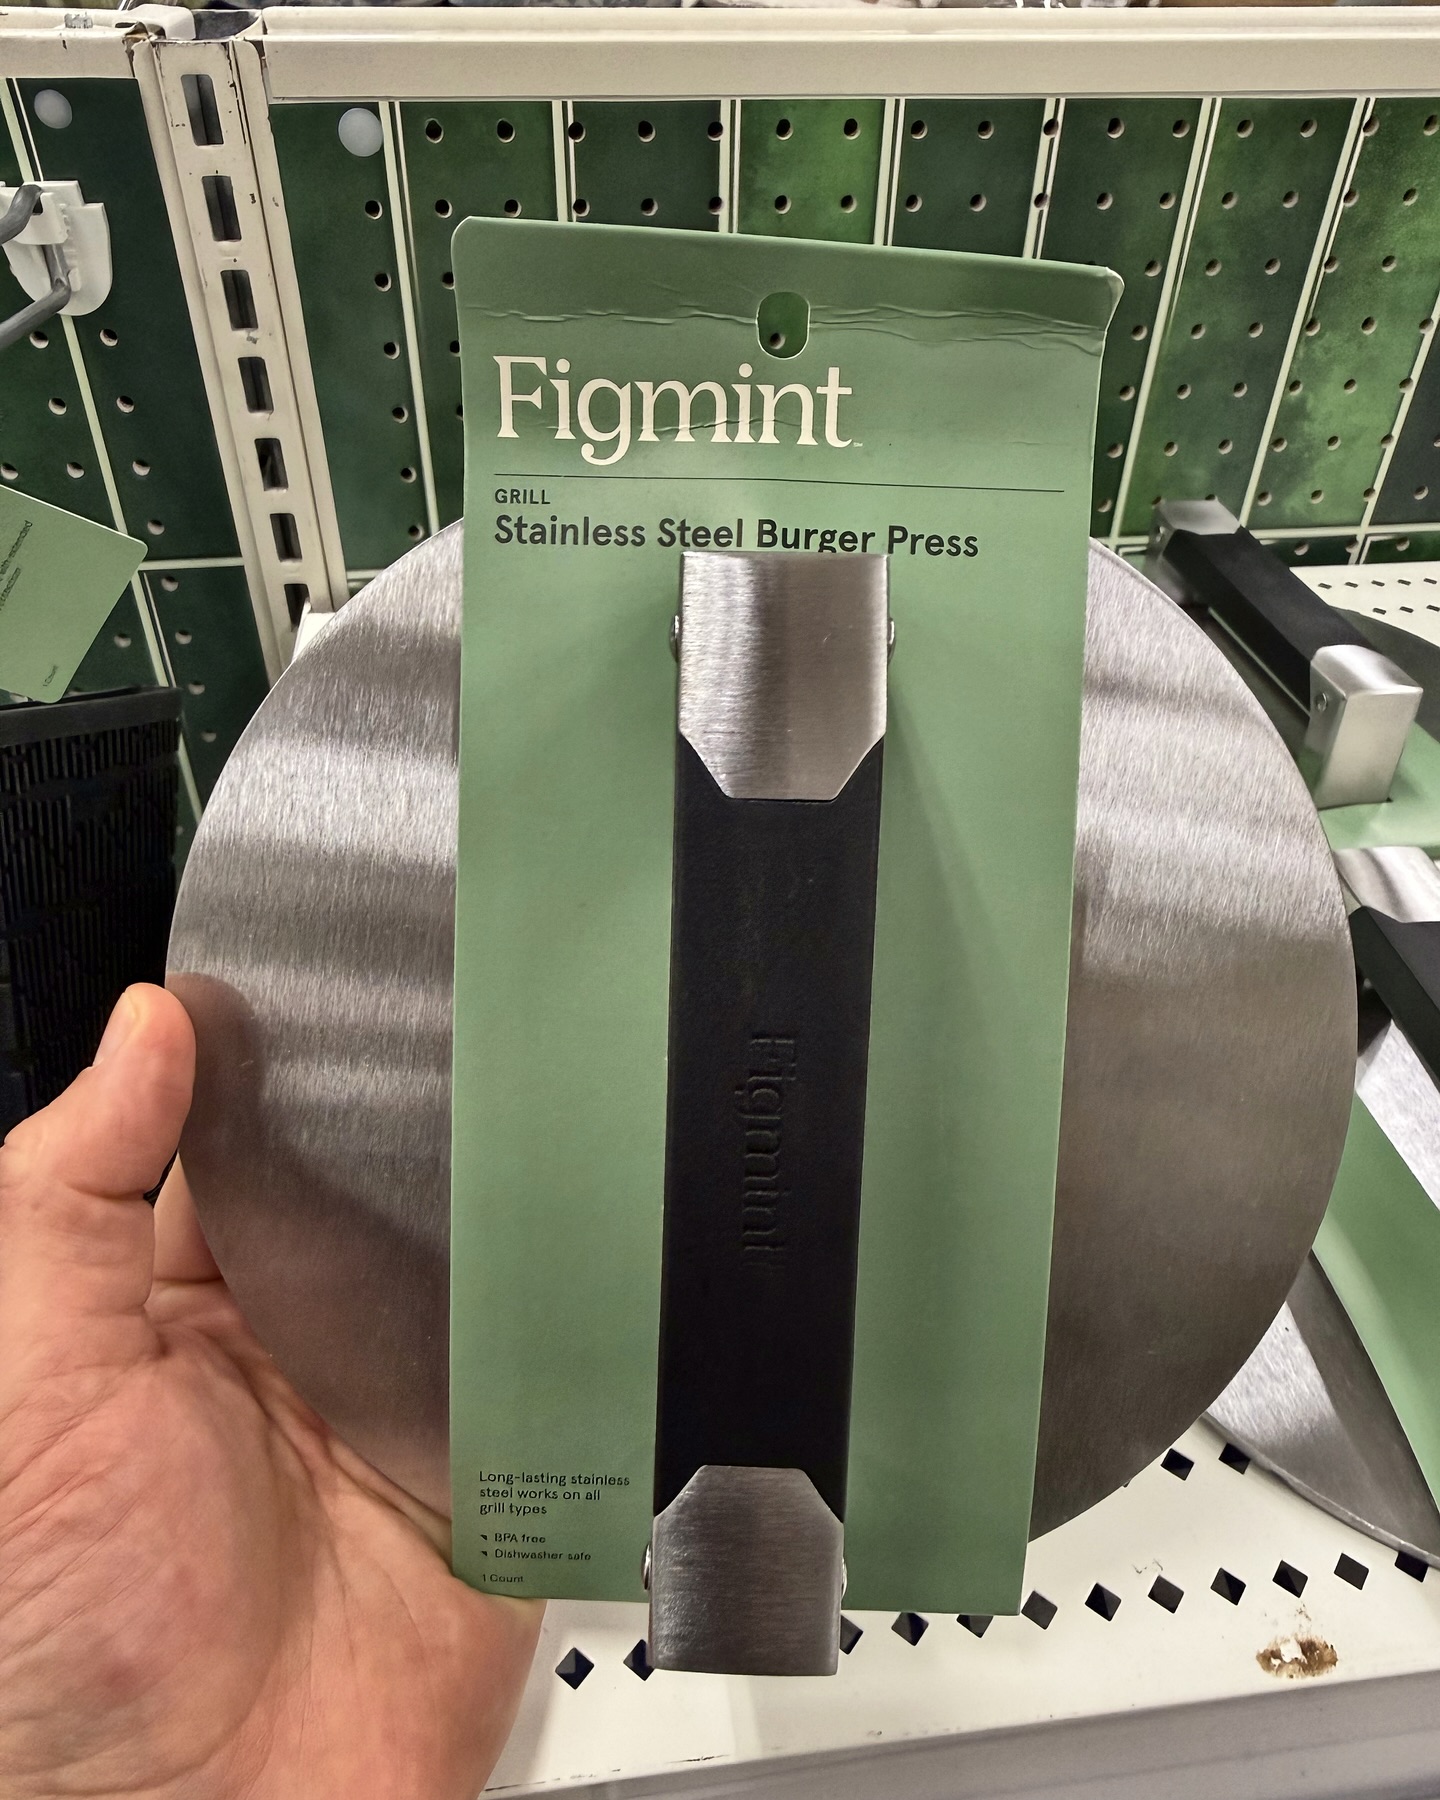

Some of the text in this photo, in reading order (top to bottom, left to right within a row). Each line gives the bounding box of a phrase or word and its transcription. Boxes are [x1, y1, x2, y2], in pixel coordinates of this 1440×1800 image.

[493, 355, 853, 466] Figmint
[494, 488, 551, 505] GRILL
[494, 514, 979, 557] Stainless Steel Burger Press
[479, 1470, 630, 1487] Long-lasting stainless
[479, 1487, 600, 1501] steel works on all
[479, 1502, 547, 1516] grill types
[494, 1532, 546, 1544] BPA free
[494, 1548, 592, 1561] Dishwasher safe
[482, 1573, 524, 1583] 1 Count
